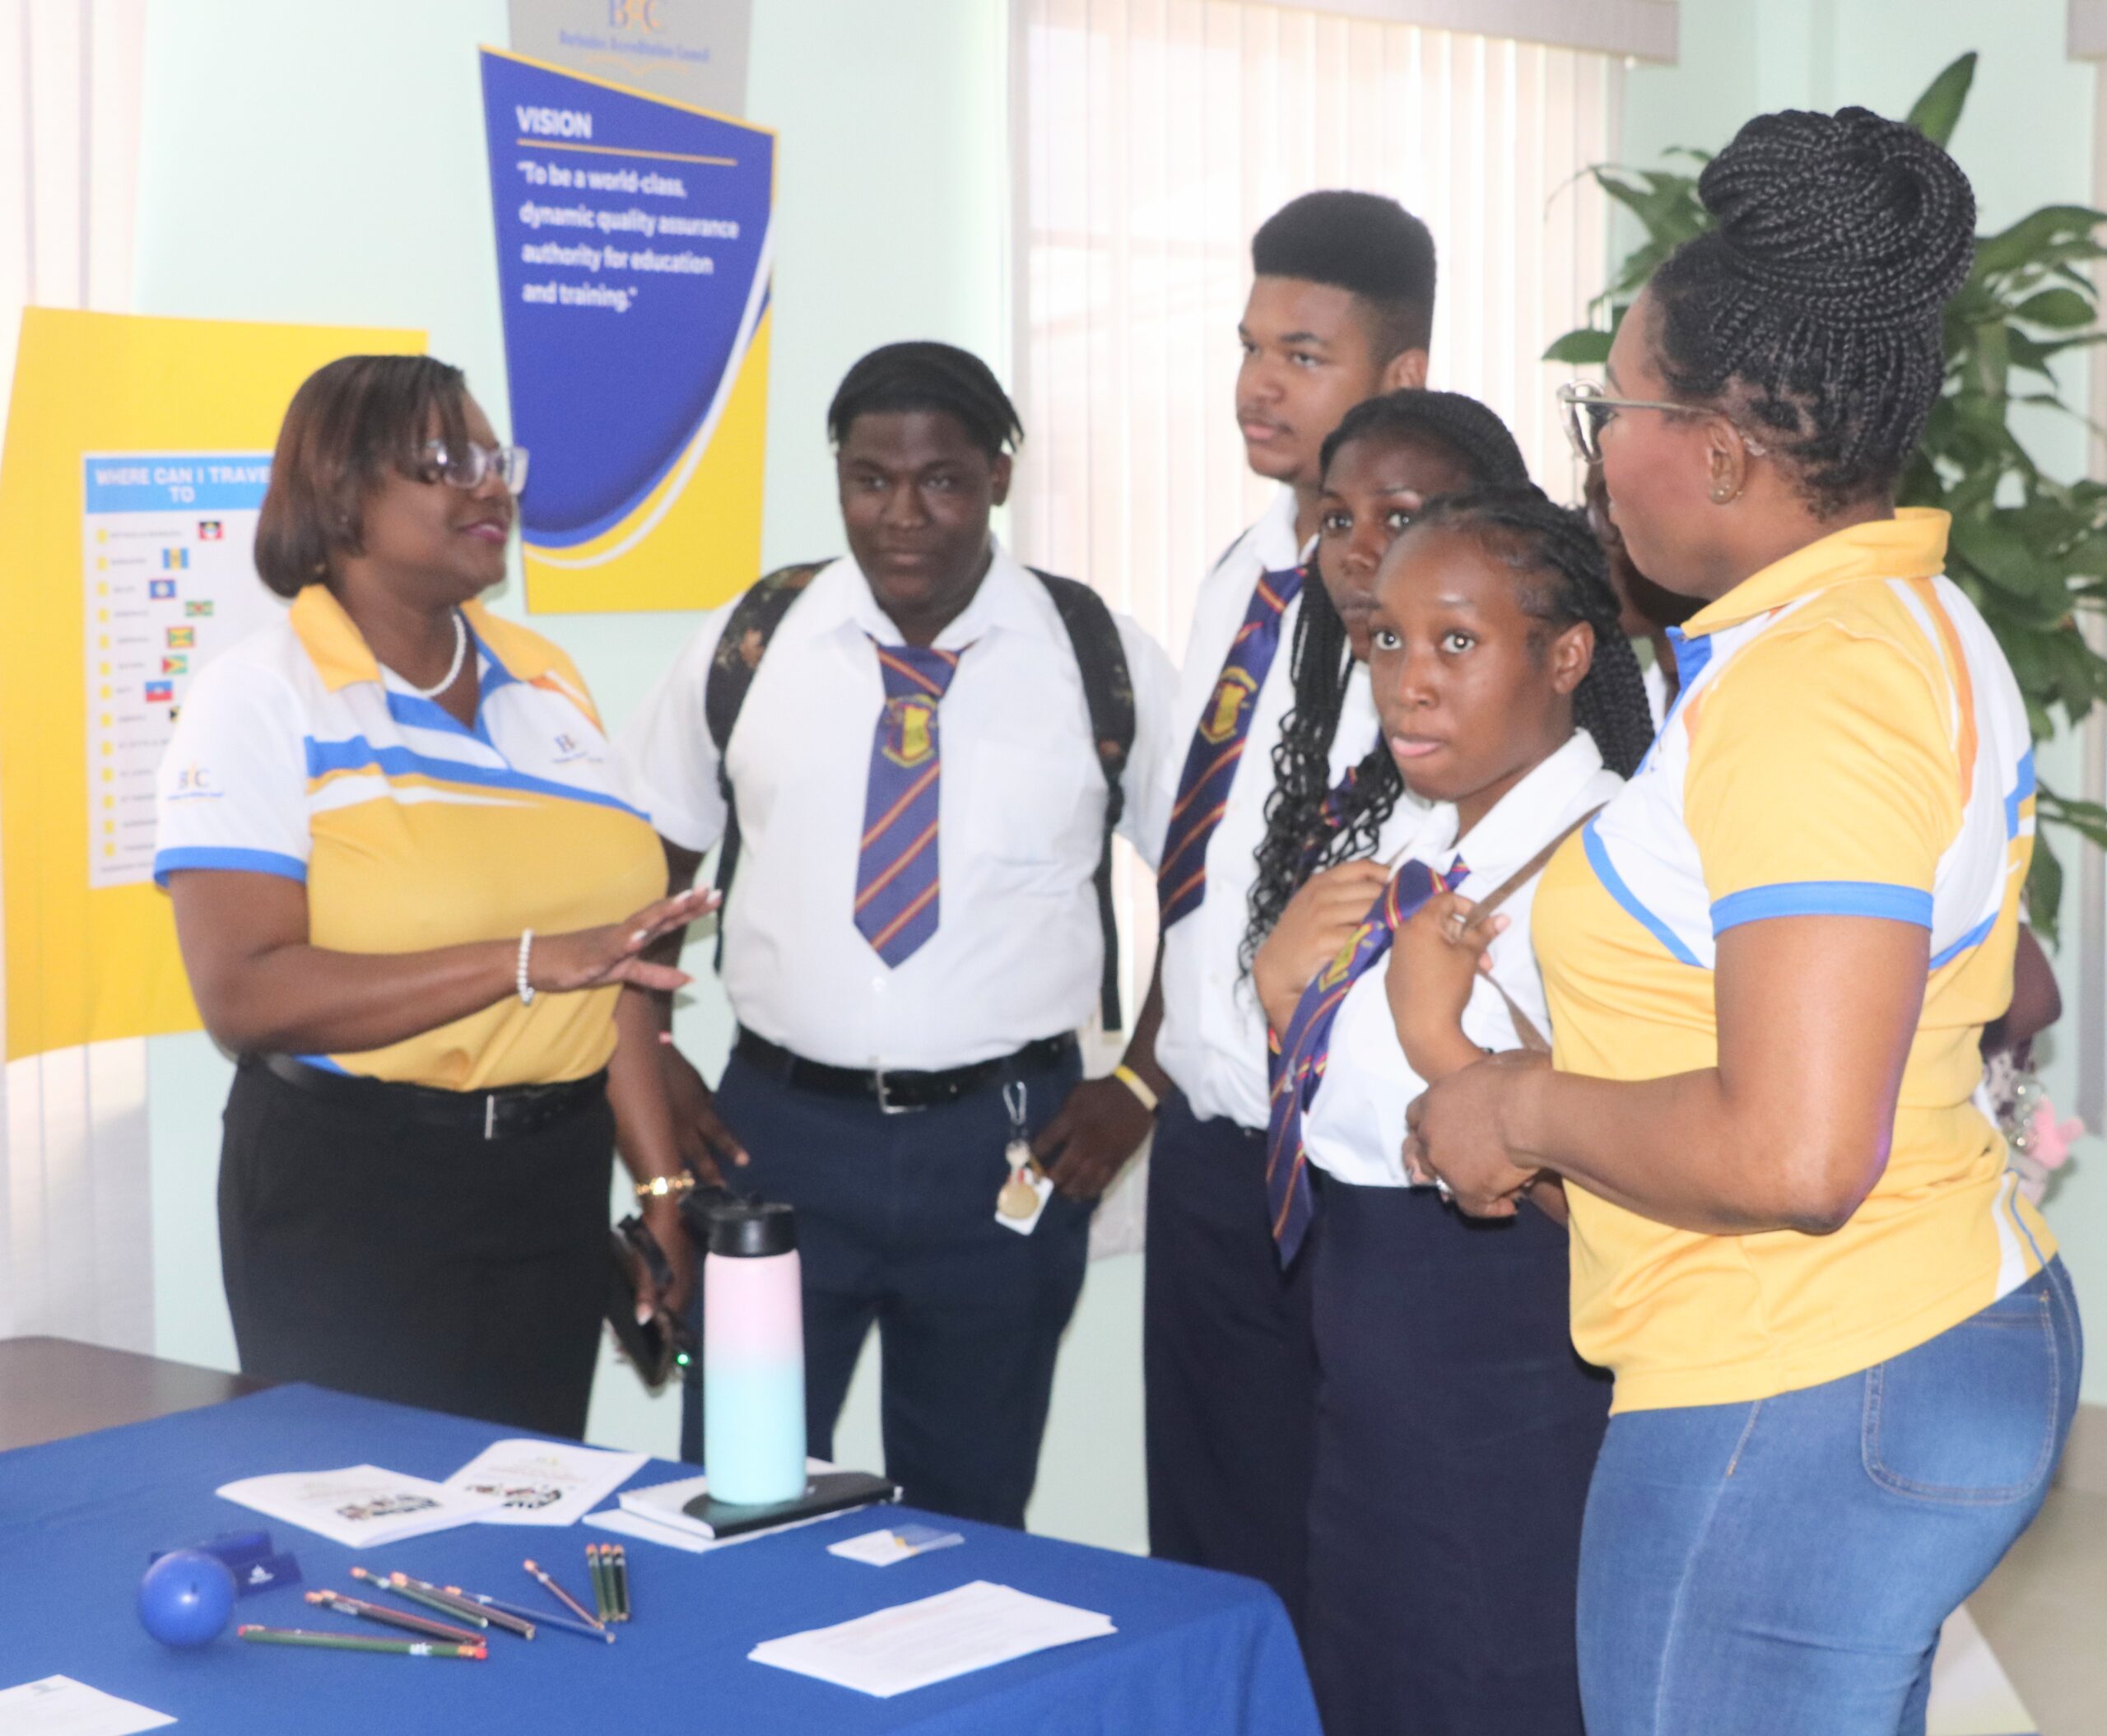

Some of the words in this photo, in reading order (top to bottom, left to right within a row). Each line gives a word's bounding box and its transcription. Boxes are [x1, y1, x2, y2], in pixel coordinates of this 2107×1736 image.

[516, 105, 592, 138] VISION
[548, 162, 572, 188] be
[574, 170, 586, 188] a
[588, 169, 688, 198] world-class,
[519, 200, 595, 230] dynamic
[596, 207, 656, 238] quality
[658, 216, 740, 240] assurance
[521, 241, 602, 272] authority
[603, 245, 629, 269] for
[630, 247, 714, 275] education
[522, 282, 557, 304] and
[95, 467, 150, 486] WHERE
[153, 467, 193, 485] CAN
[197, 467, 205, 484] I
[207, 465, 271, 484] TRAVE
[168, 486, 196, 503] TO
